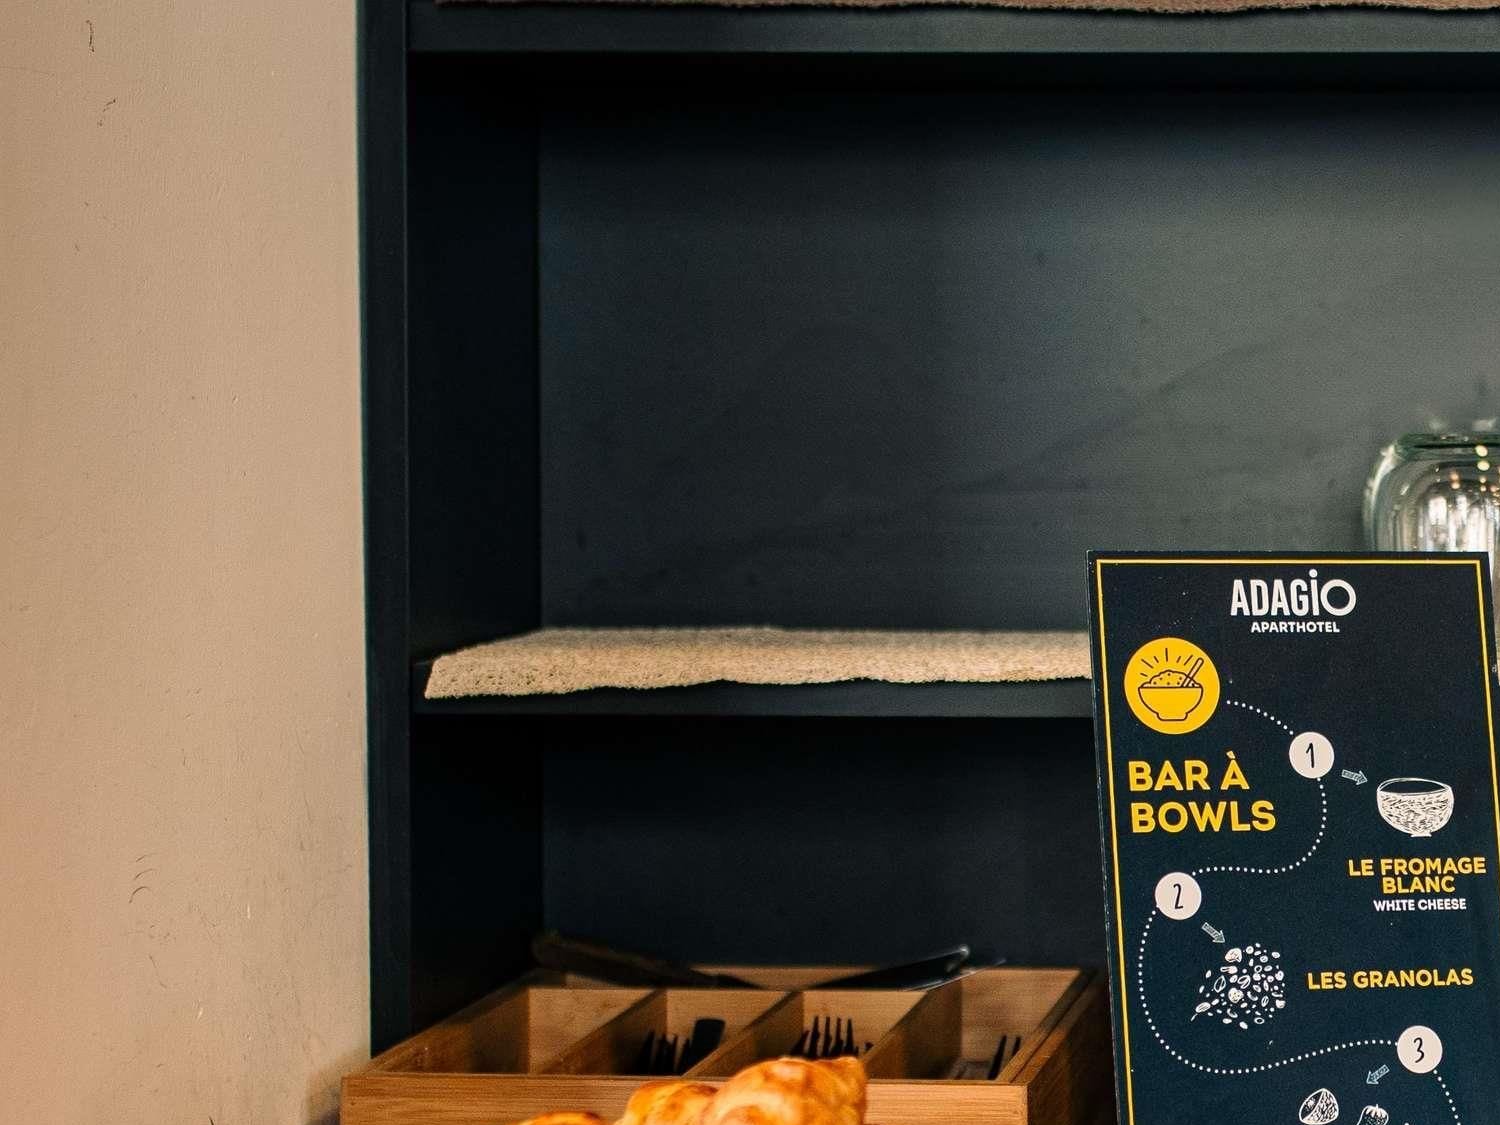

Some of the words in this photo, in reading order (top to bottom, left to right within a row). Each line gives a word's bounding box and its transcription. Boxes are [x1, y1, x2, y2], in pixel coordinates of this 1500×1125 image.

[1250, 621, 1342, 633] APARTHOTEL
[1304, 742, 1315, 769] 1
[1128, 759, 1211, 792] BAR
[1220, 750, 1250, 791] À
[1130, 800, 1277, 833] BOWLS
[1348, 858, 1375, 877] LE
[1380, 856, 1487, 876] FROMAGE
[1173, 883, 1184, 910] 2
[1382, 875, 1456, 894] BLANC
[1372, 899, 1416, 912] WHITE
[1417, 898, 1467, 911] CHEESE
[1307, 971, 1347, 990] LES
[1353, 968, 1474, 989] GRANOLAS
[1413, 1037, 1425, 1064] 3
